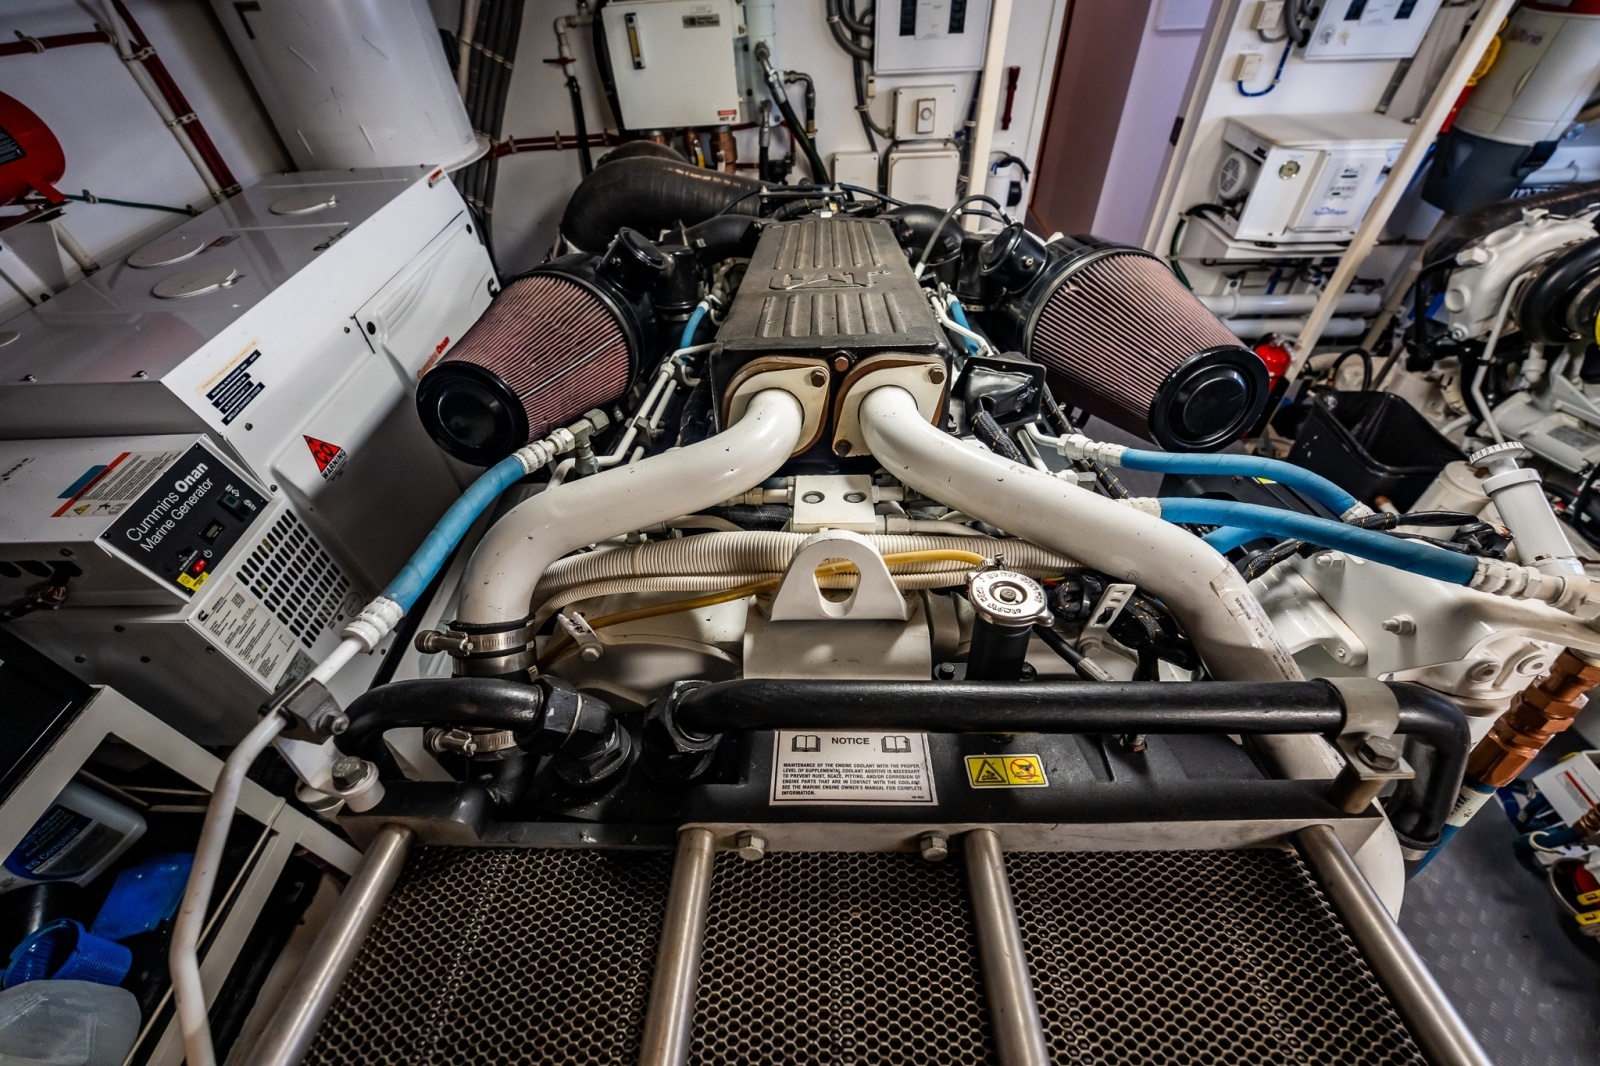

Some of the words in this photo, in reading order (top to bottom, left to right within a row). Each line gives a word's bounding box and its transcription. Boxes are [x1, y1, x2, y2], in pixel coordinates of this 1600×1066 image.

[769, 271, 877, 290] CAT
[313, 443, 334, 464] CO
[322, 449, 347, 480] WARNING
[126, 492, 180, 541] Cummins
[174, 462, 209, 493] Onan
[140, 519, 176, 552] Marine
[171, 478, 214, 520] Generator
[831, 737, 870, 745] NOTICE
